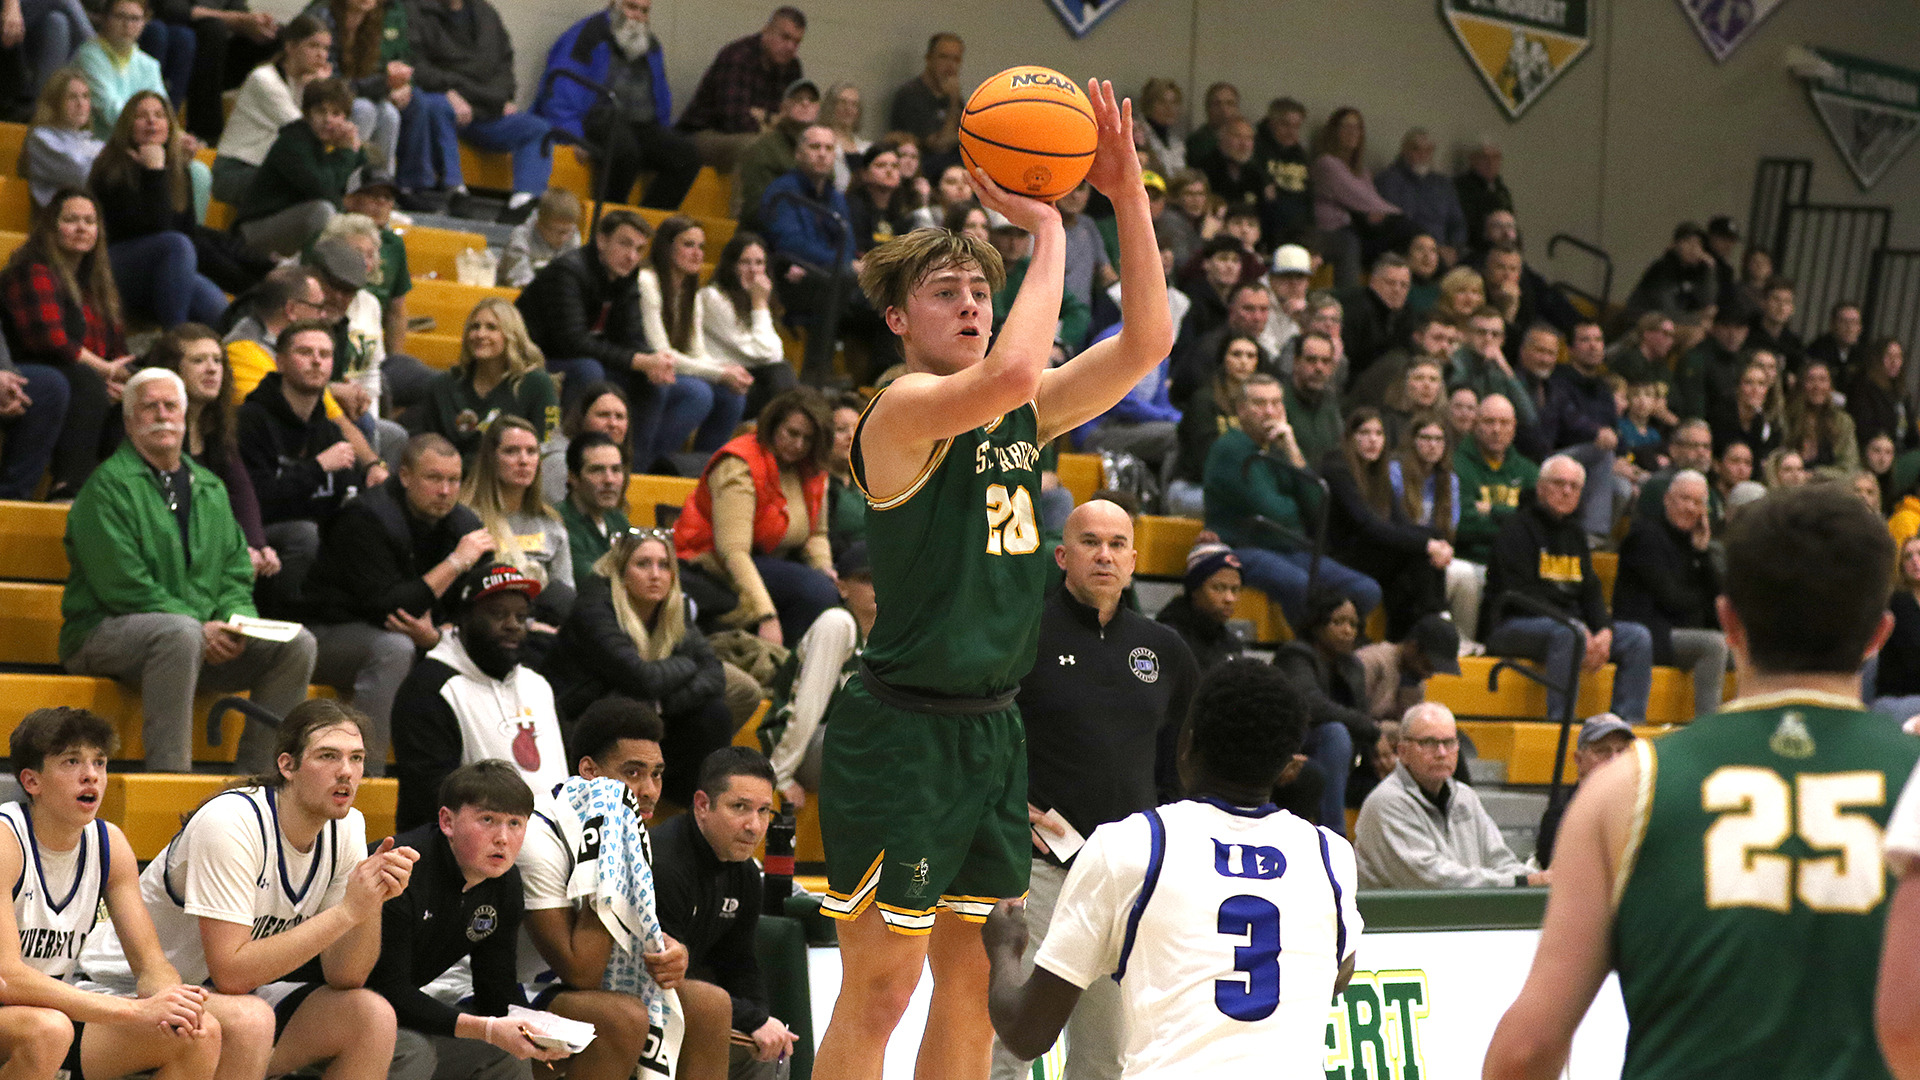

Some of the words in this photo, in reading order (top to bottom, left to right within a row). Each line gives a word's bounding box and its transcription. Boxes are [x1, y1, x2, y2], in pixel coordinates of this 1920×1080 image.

[1010, 73, 1076, 96] NCAA
[985, 483, 1040, 556] 20
[1702, 765, 1887, 915] 25
[1215, 894, 1282, 1022] 3
